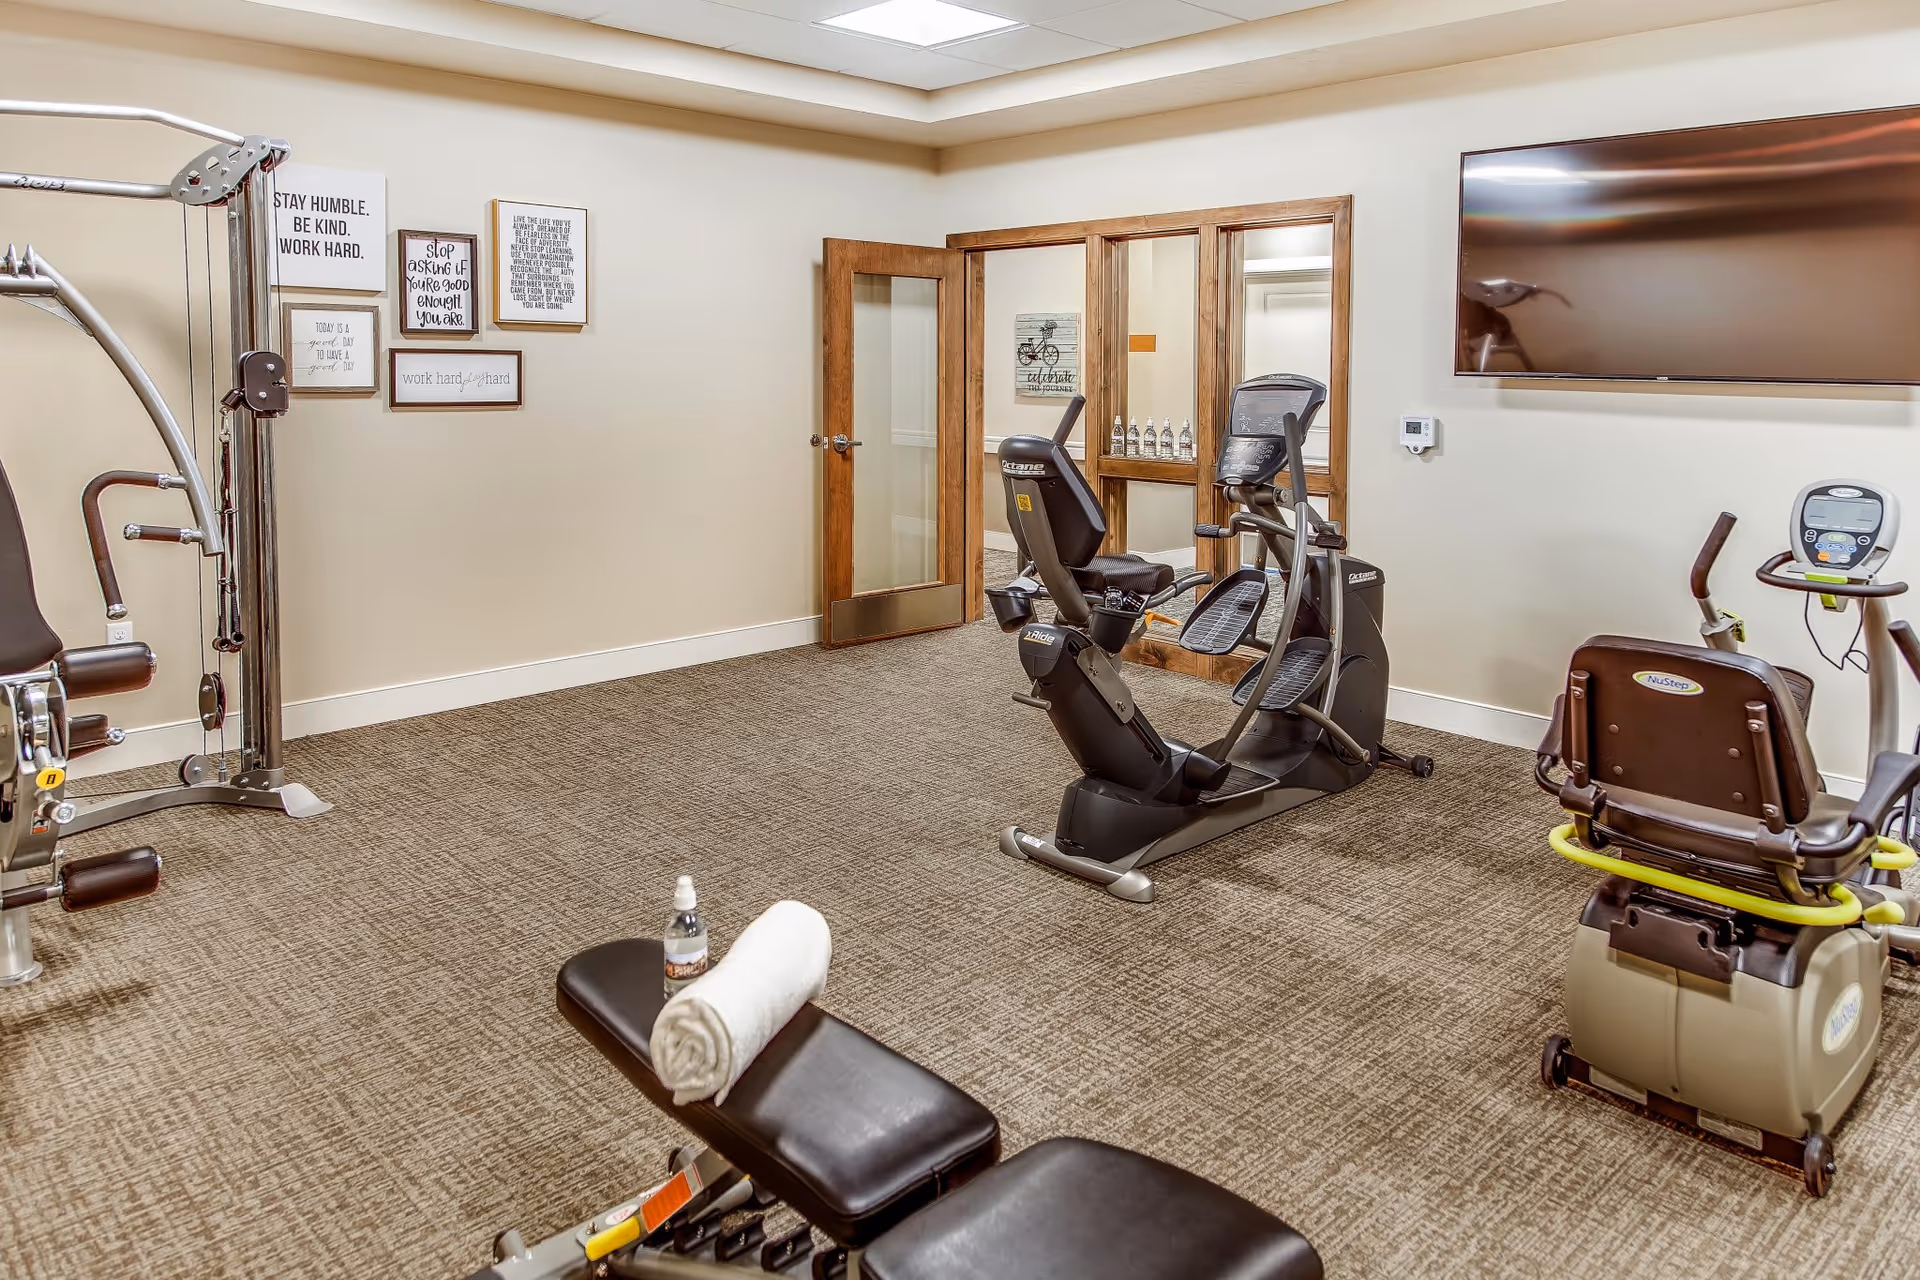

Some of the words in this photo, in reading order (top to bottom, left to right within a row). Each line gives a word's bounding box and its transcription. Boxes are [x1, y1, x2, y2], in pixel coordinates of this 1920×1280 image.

[274, 192, 306, 210] STAY
[311, 196, 370, 216] HUMBLE.
[294, 216, 310, 233] BE
[316, 218, 350, 236] KIND.
[537, 225, 563, 233] DREAMED
[524, 230, 551, 239] FEARLESS
[280, 238, 320, 256] WORK
[324, 241, 364, 260] HARD.
[539, 254, 574, 262] IMAGINATION
[316, 322, 334, 333] TODAY
[337, 323, 342, 333] IS
[345, 324, 350, 333] A
[308, 336, 338, 351] good
[343, 337, 354, 347] DAY
[317, 350, 324, 360] TO
[327, 350, 342, 360] HAVE
[345, 351, 349, 360] A
[308, 361, 337, 375] good
[344, 361, 354, 371] DAY
[402, 372, 432, 384] work
[436, 372, 462, 384] hard
[486, 372, 510, 384] hard
[1002, 460, 1044, 470] Octane
[1026, 630, 1056, 642] xRide
[1648, 676, 1689, 690] NuStep
